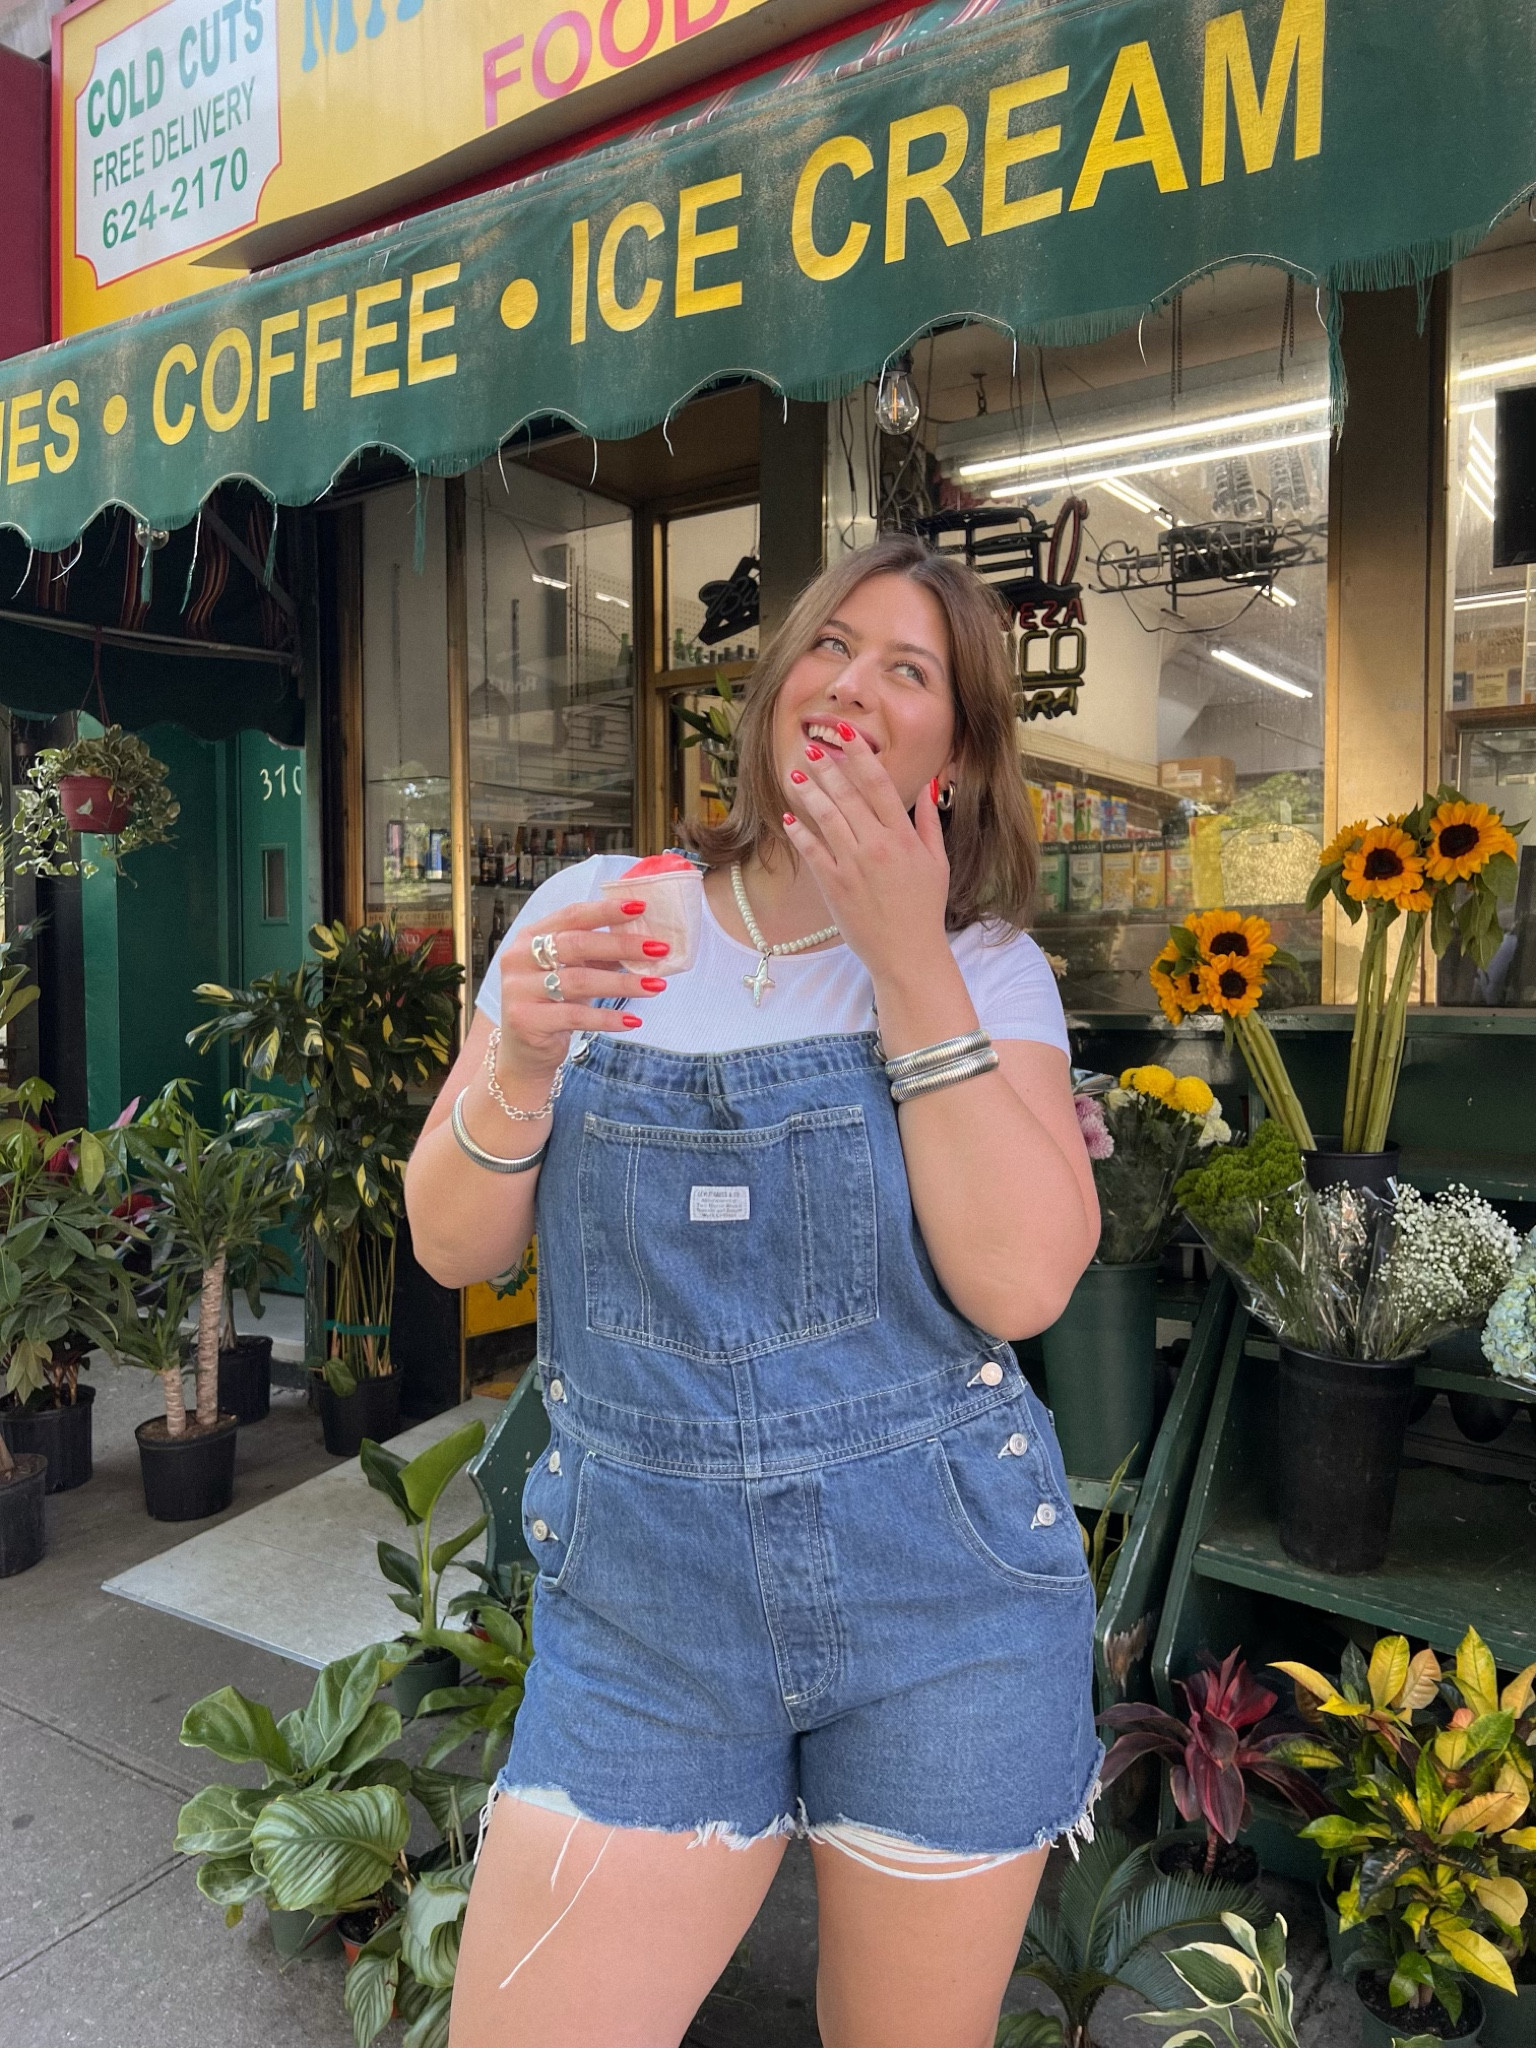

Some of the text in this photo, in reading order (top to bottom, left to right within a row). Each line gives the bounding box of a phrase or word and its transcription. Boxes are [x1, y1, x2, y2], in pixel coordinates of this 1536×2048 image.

[87, 46, 165, 138] COLD
[178, 0, 264, 89] CUTS
[93, 75, 256, 198] FREE DELIVERY
[102, 146, 249, 249] 624-2170
[569, 0, 1325, 346] ICE CREAM
[152, 261, 462, 446] COFFEE
